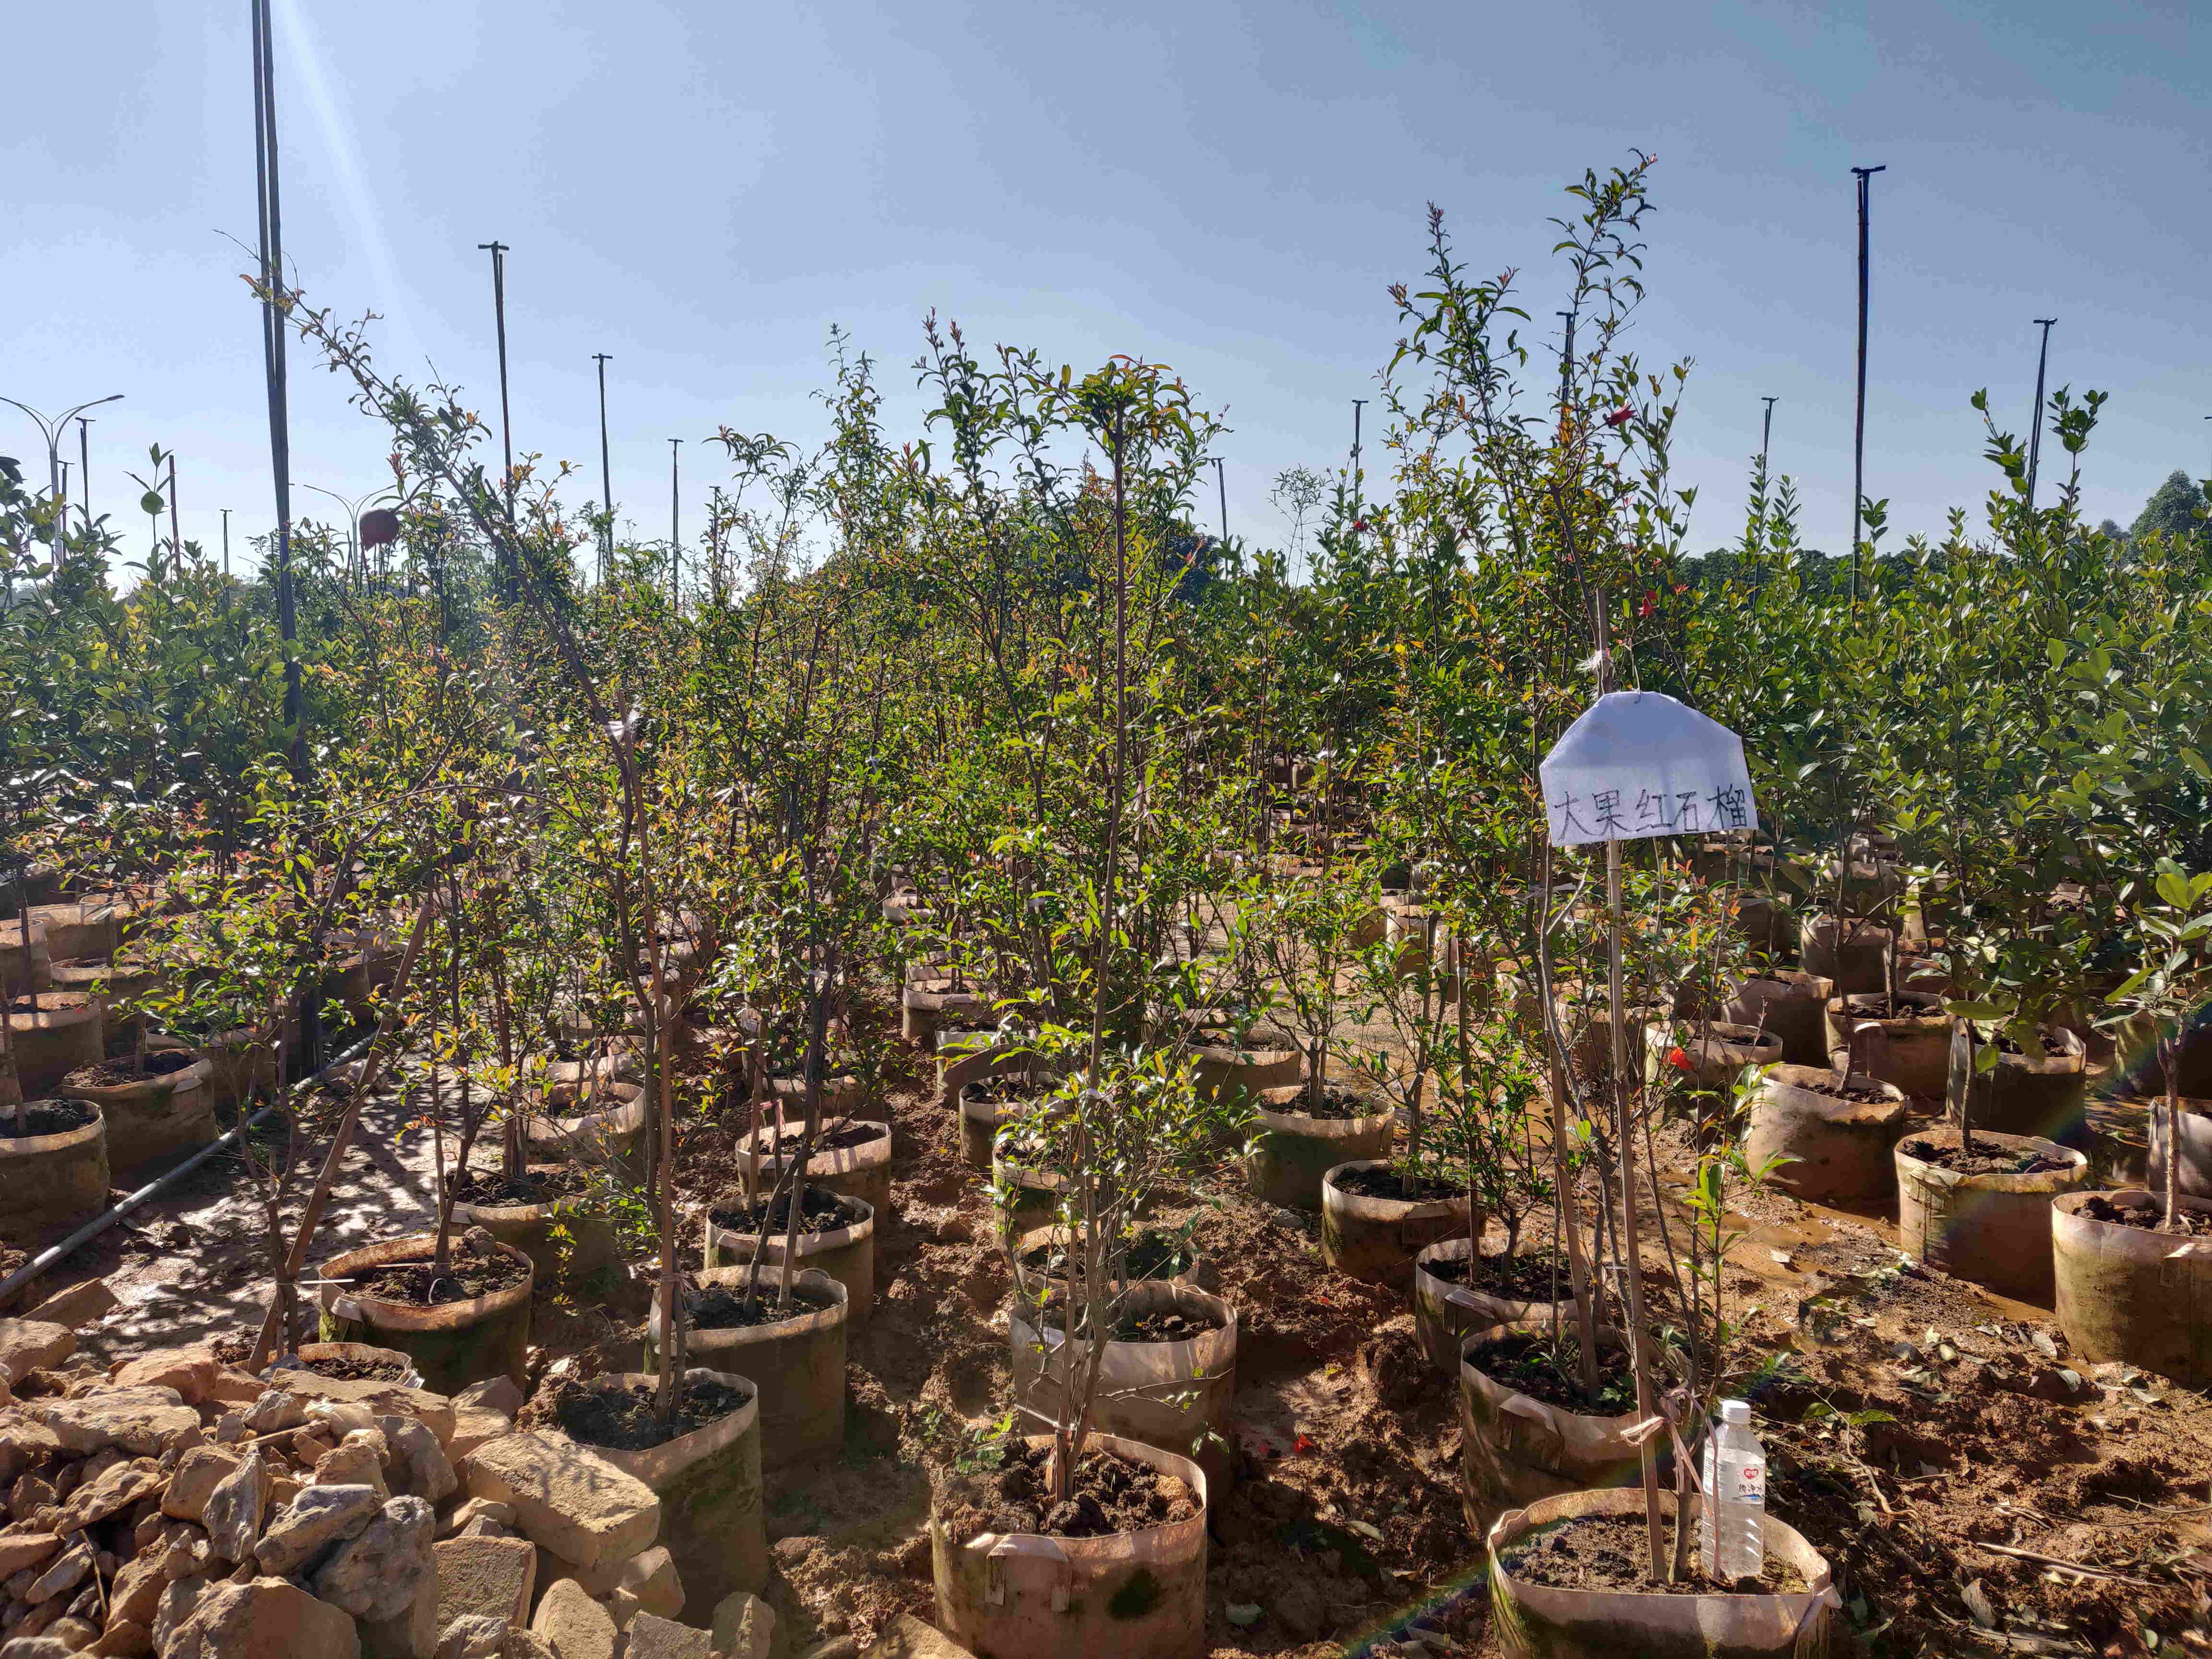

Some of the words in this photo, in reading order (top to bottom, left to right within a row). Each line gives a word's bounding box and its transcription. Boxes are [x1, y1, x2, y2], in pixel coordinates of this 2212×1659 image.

[1553, 783, 1747, 842] 大果红石榴
